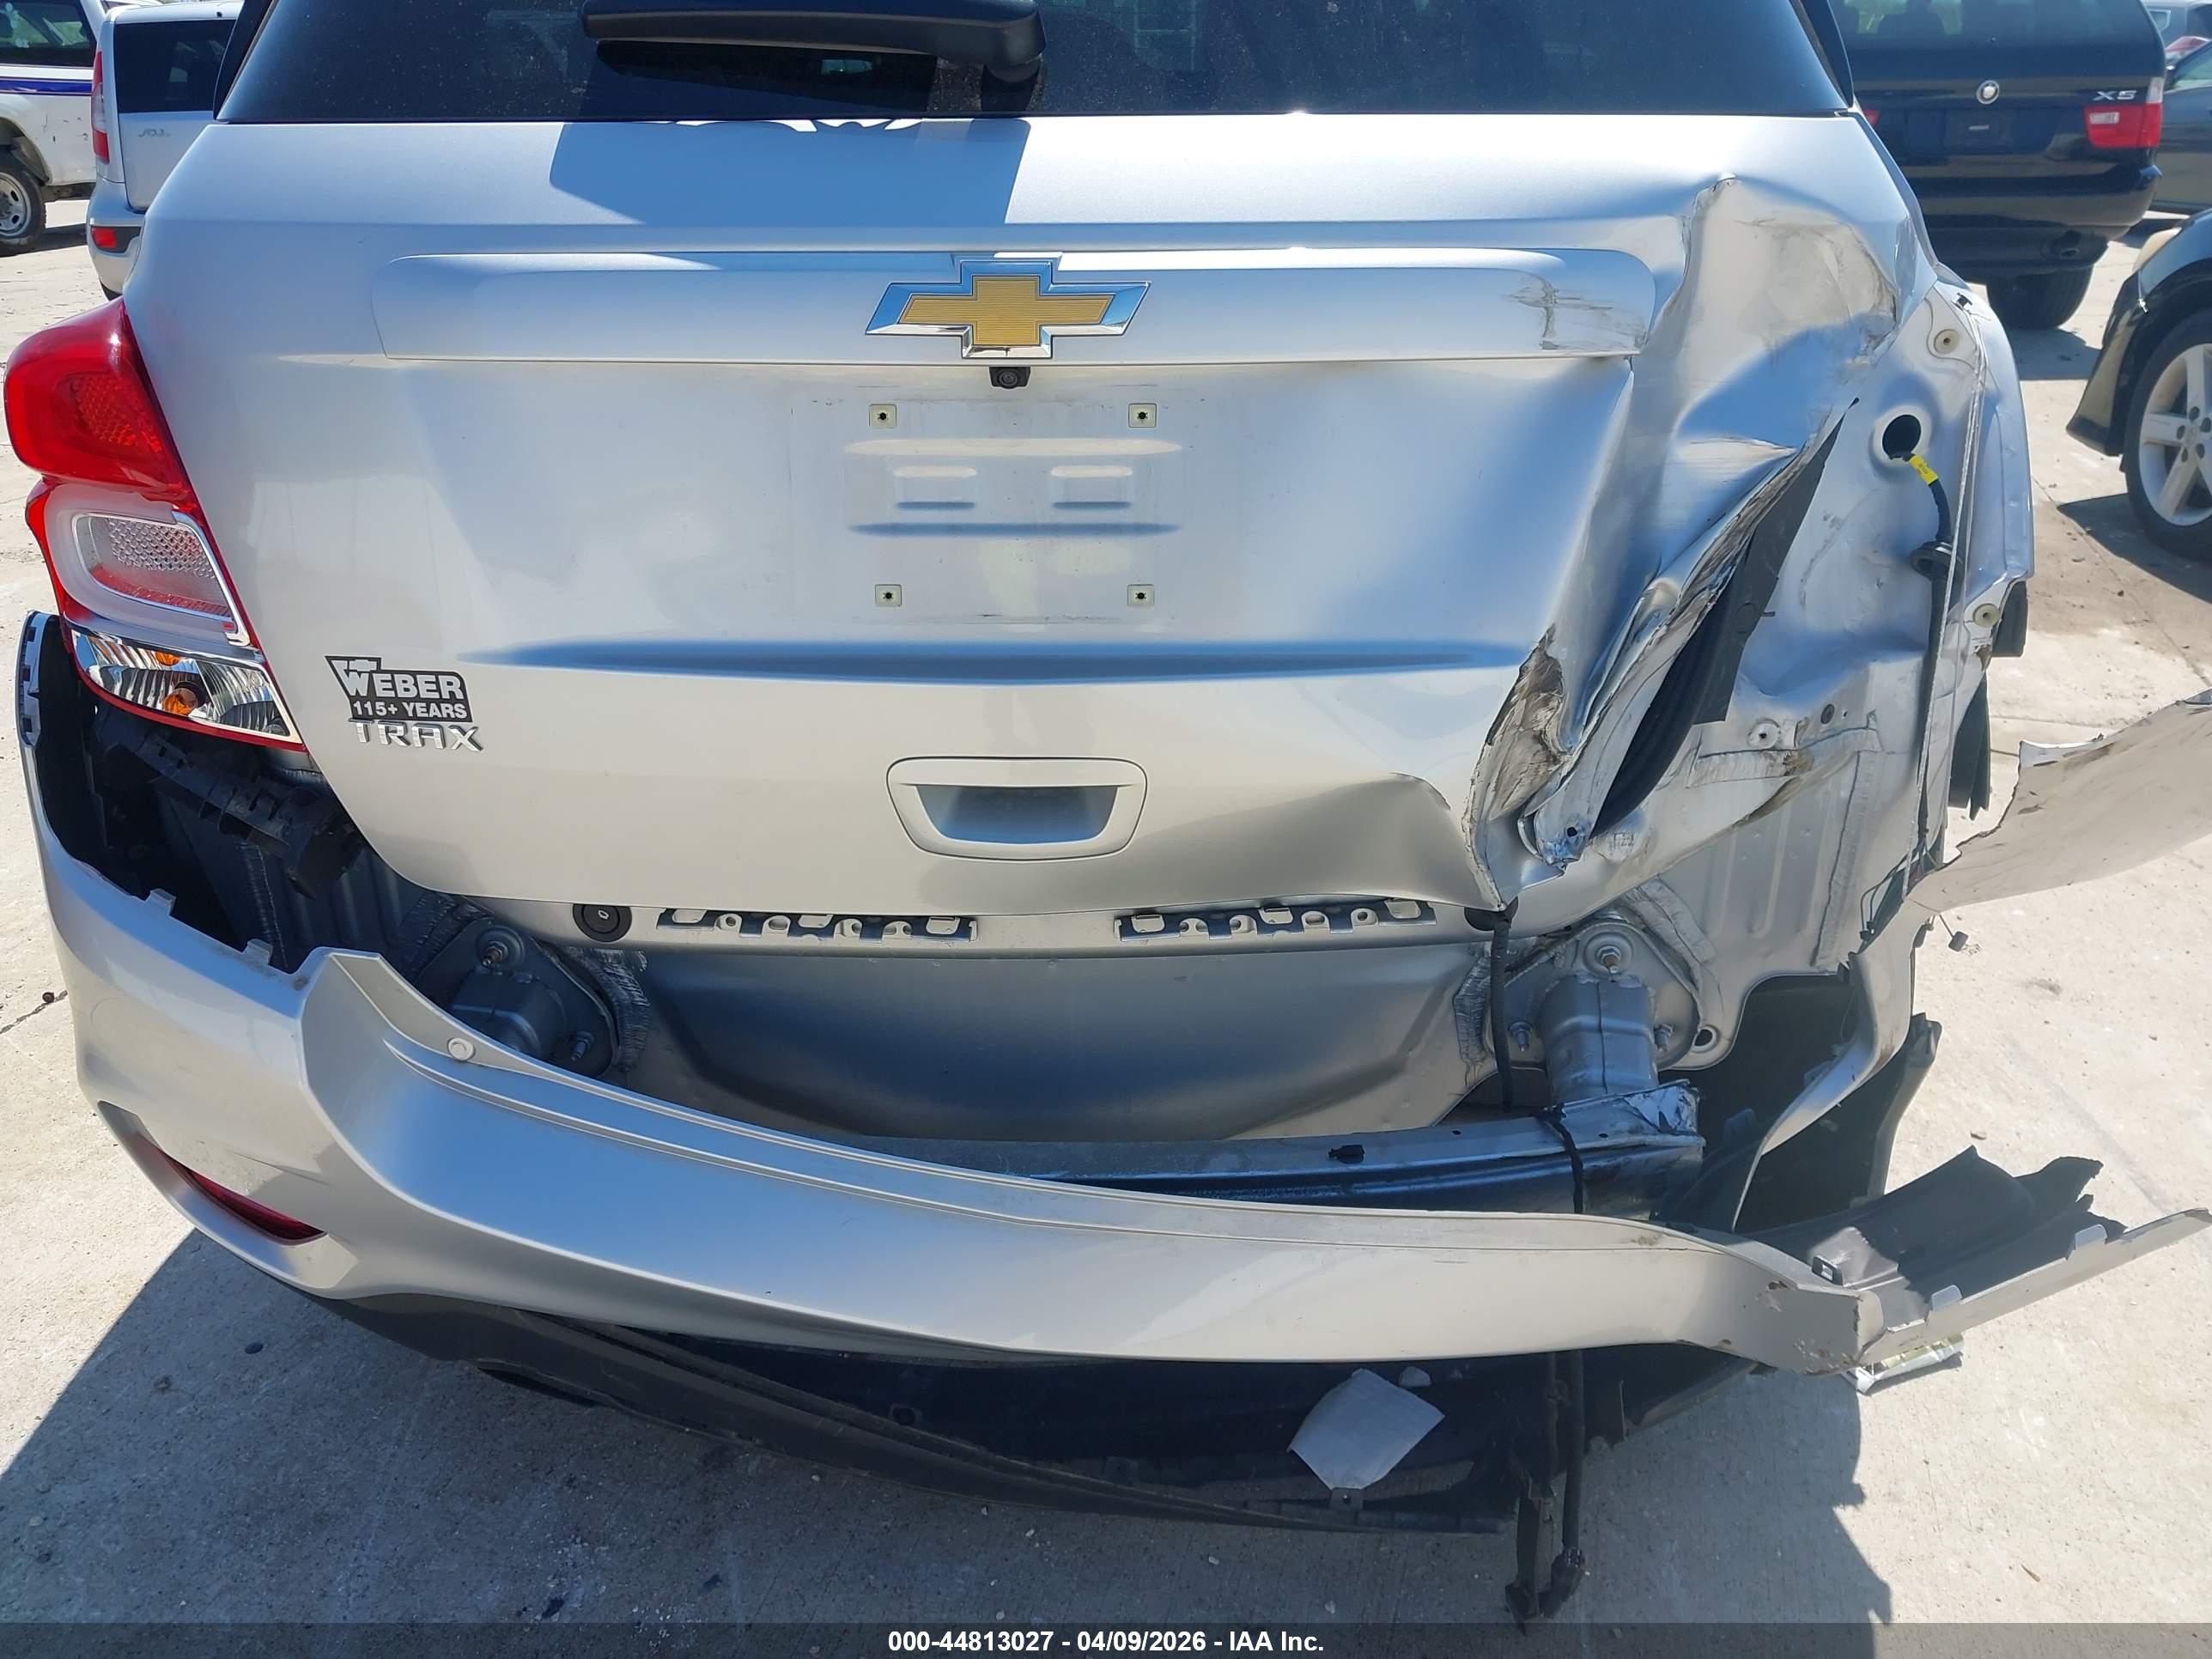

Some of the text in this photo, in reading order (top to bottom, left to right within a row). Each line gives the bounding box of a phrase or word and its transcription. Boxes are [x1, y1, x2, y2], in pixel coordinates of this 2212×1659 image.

[2093, 89, 2137, 101] X5
[331, 659, 465, 700] WEBER
[353, 700, 467, 720] 115+ YEARS
[349, 718, 483, 752] TRAX
